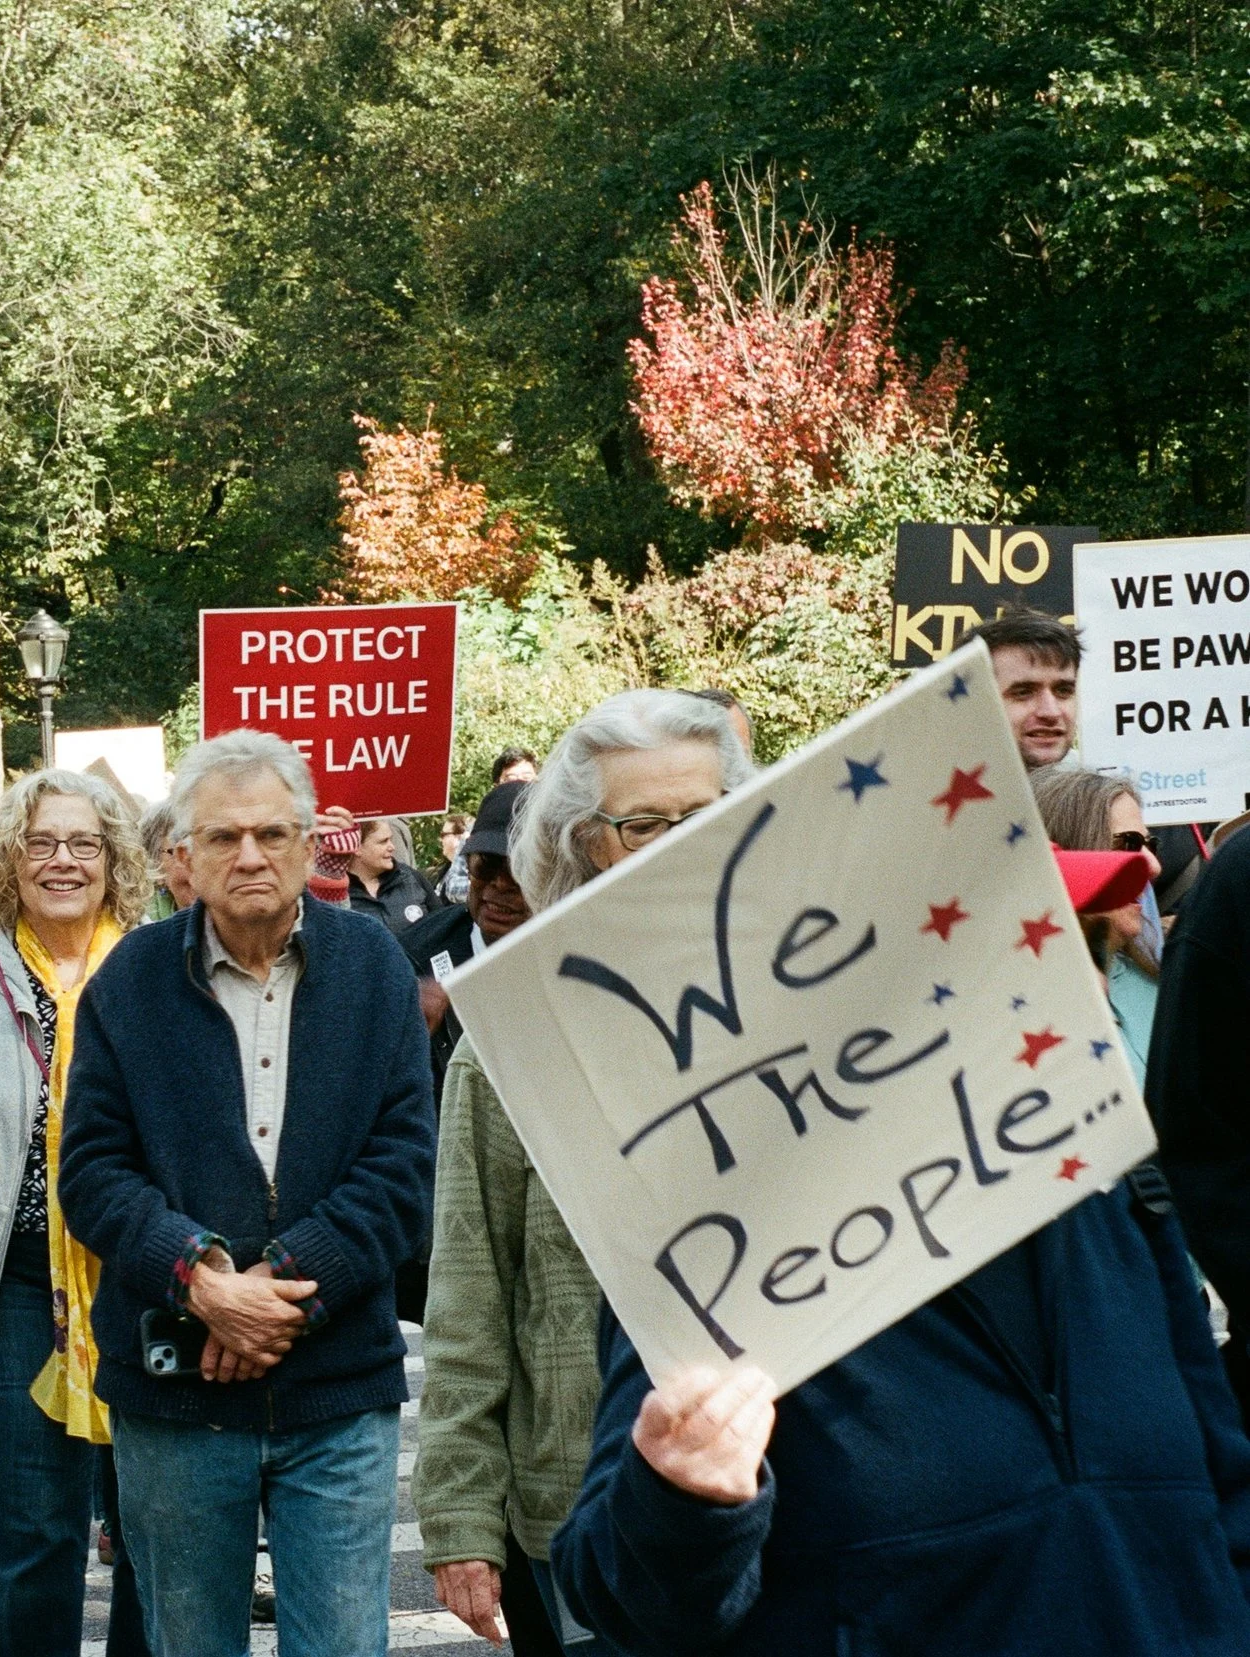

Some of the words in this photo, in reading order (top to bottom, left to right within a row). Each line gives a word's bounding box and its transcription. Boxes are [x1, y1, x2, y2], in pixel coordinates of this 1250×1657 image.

[951, 528, 1049, 584] NO
[1111, 574, 1173, 609] WE
[241, 625, 426, 665] PROTECT
[1113, 638, 1162, 673] BE
[1173, 632, 1250, 669] PAW
[233, 685, 316, 720] THE
[329, 680, 428, 718] RULE
[1115, 700, 1192, 736] FOR
[1202, 697, 1230, 730] A
[326, 734, 410, 772] LAW
[1139, 768, 1207, 791] Street
[556, 801, 876, 1072] We
[620, 1027, 950, 1176] The
